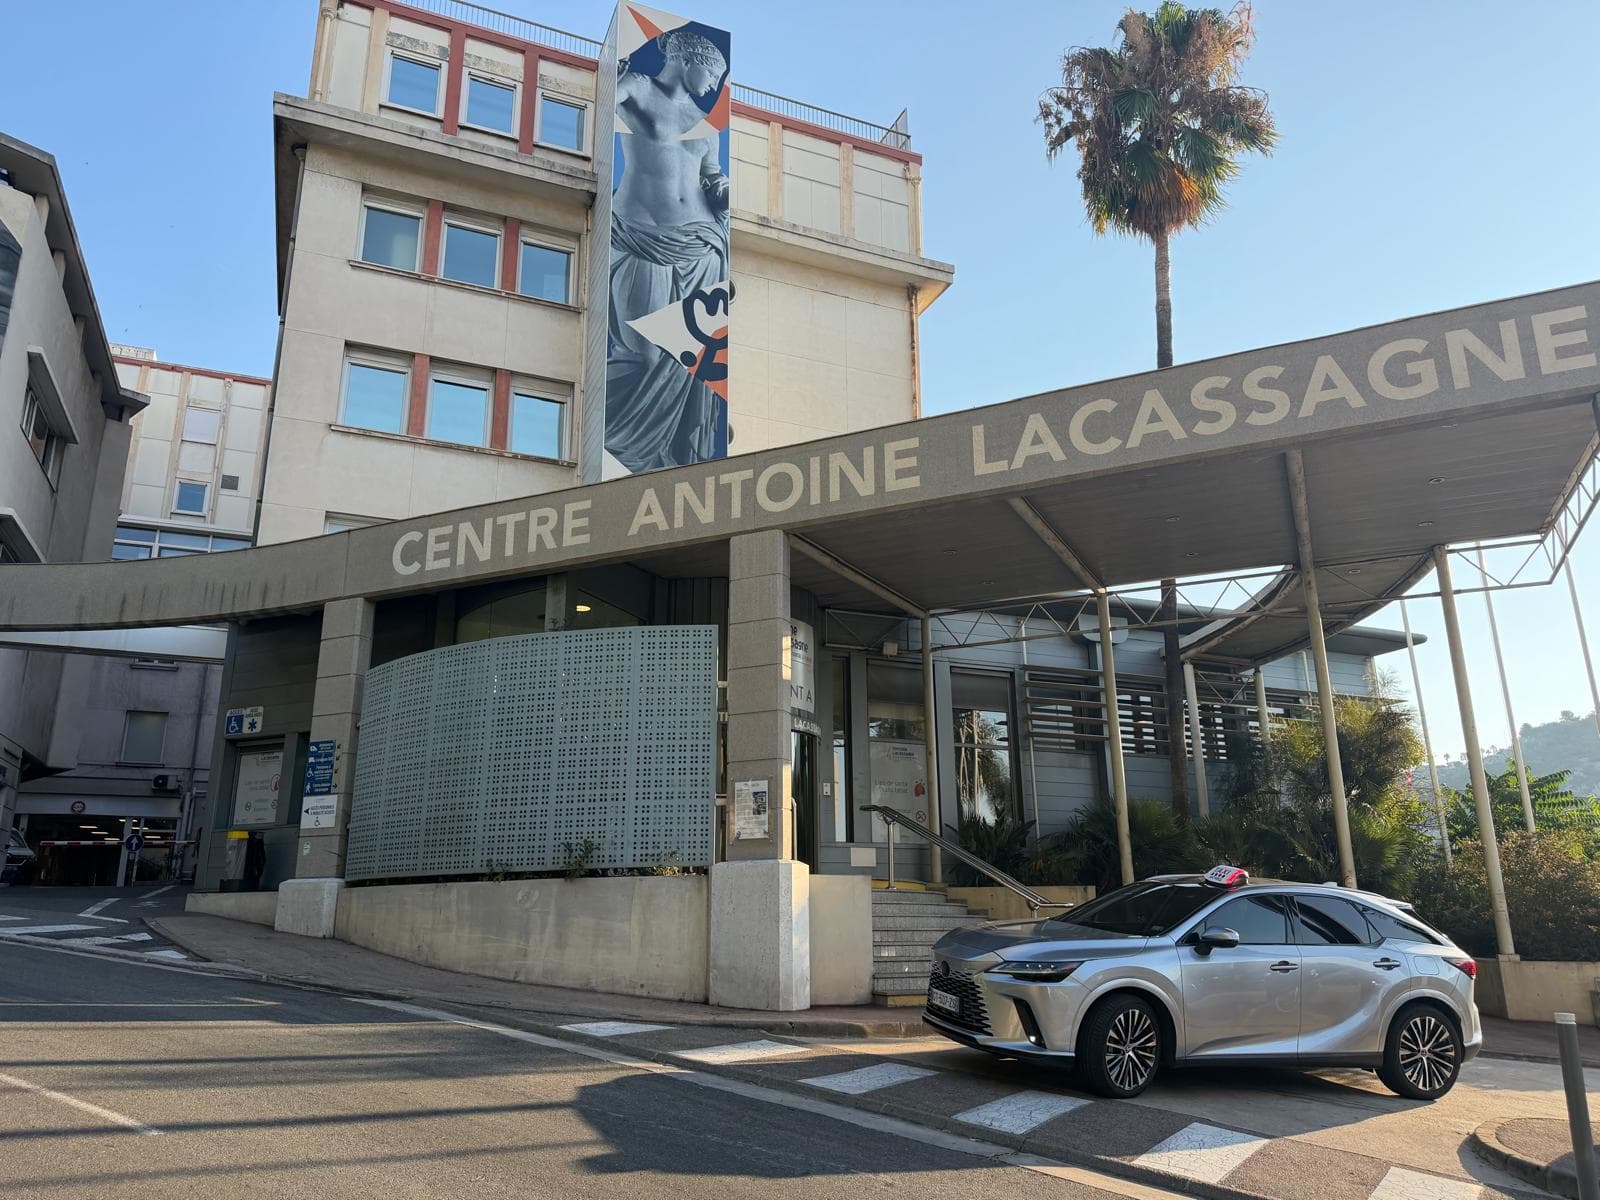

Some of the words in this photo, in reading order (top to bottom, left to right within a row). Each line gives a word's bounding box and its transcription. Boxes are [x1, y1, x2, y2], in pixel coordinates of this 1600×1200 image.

[392, 499, 592, 575] CENTRE
[626, 436, 921, 537] ANTOINE
[972, 304, 1598, 476] LACASSAGNE
